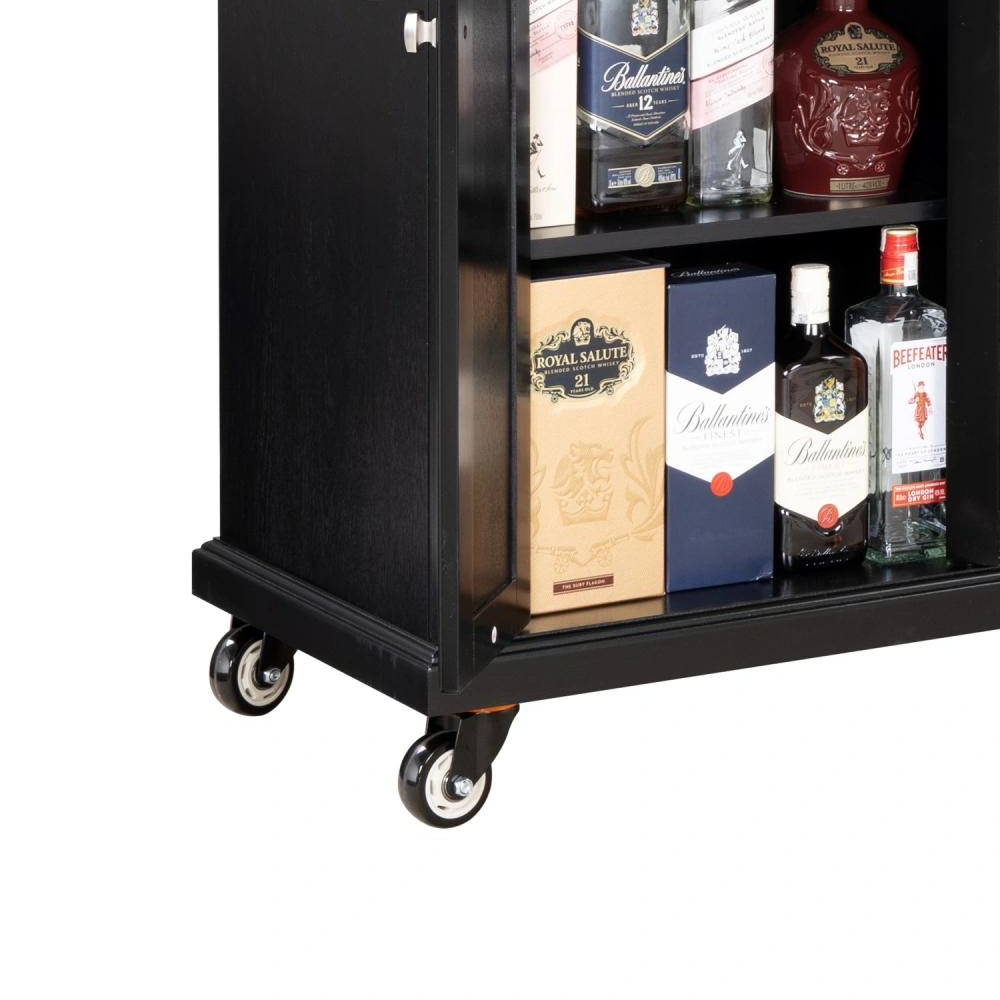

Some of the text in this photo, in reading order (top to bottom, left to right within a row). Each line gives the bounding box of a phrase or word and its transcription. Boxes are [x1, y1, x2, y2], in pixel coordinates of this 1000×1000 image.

[733, 44, 753, 56] SCOTCH
[820, 42, 896, 54] ROYAL SALUTE
[855, 57, 868, 66] 21
[601, 61, 686, 93] Ballantine's
[611, 89, 637, 97] BLENDED
[637, 87, 659, 95] SCOTCH
[639, 94, 653, 111] 12
[536, 346, 628, 369] ROYAL SALUTE
[893, 343, 947, 369] BEEFEATER
[544, 367, 570, 375] BLENDED
[597, 360, 620, 368] WHISKY
[907, 361, 935, 370] LONDON
[574, 374, 590, 388] 21
[673, 400, 771, 435] Ballantine's
[703, 429, 741, 440] FINEST
[785, 436, 867, 466] Ballantine's
[908, 488, 934, 496] LONDON
[562, 579, 606, 590] THE RUBY FLAGON
